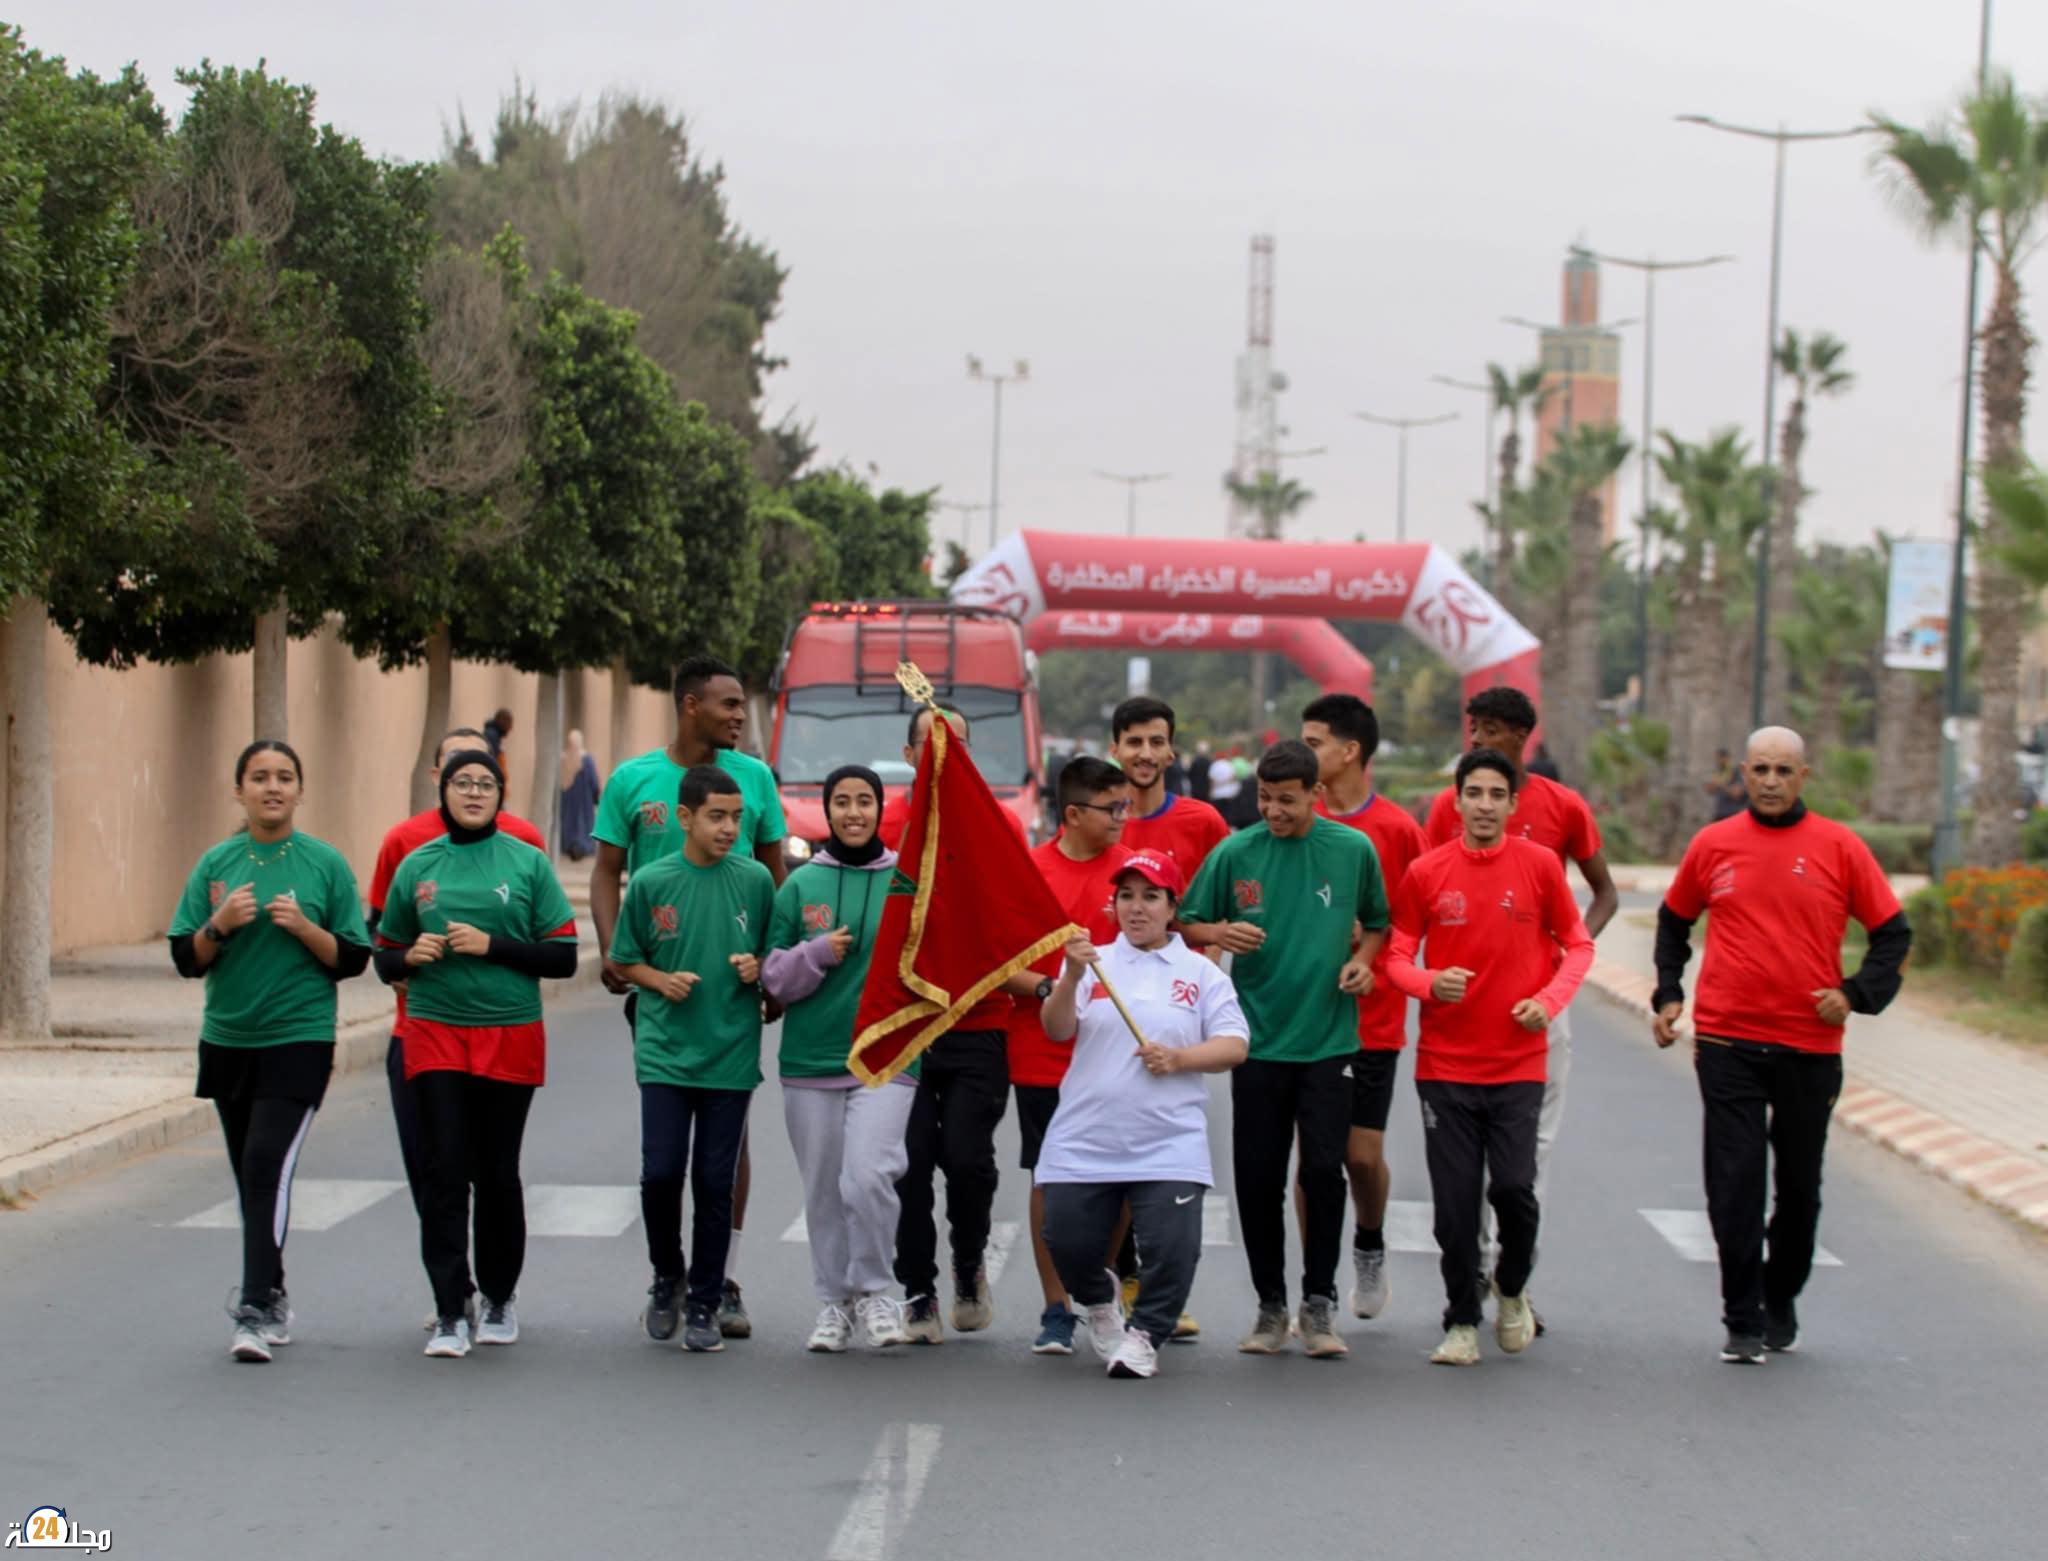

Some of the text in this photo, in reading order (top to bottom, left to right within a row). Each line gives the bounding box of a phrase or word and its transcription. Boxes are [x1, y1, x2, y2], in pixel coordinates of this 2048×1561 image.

[1047, 561, 1408, 602] ذكرى المسيرة الخضراء المظفرة
